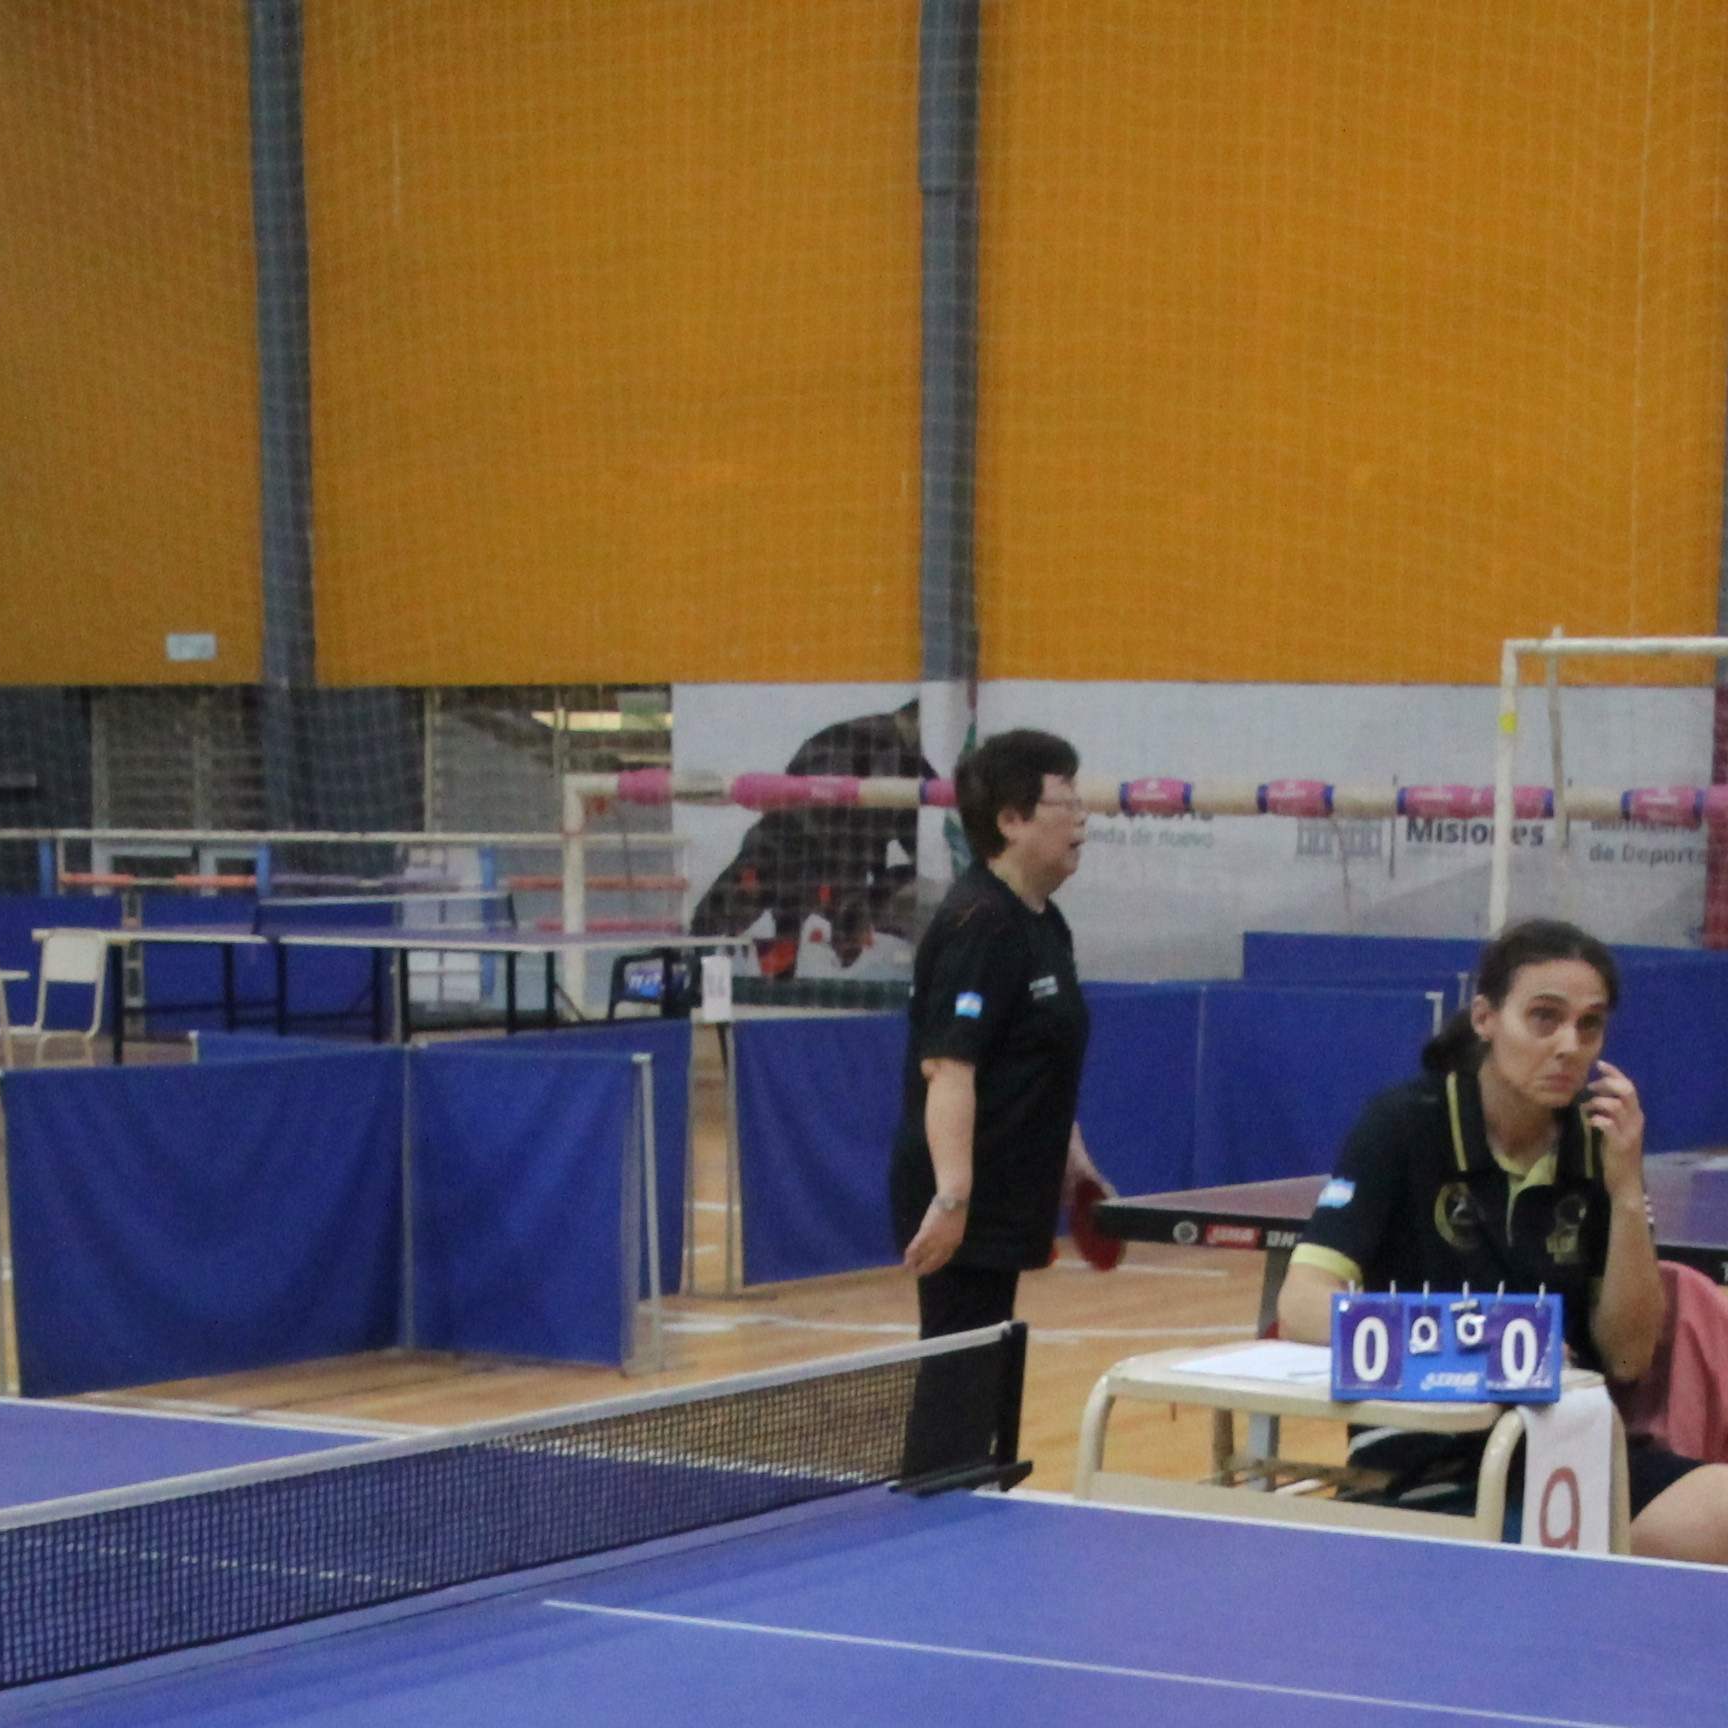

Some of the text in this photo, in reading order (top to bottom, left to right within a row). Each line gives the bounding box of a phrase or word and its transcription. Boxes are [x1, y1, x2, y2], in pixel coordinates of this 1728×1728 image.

[1405, 812, 1545, 847] Misioes
[1622, 844, 1710, 866] Deporte
[1265, 1230, 1303, 1248] DH
[1352, 1315, 1389, 1382] 0
[1501, 1317, 1539, 1387] 0
